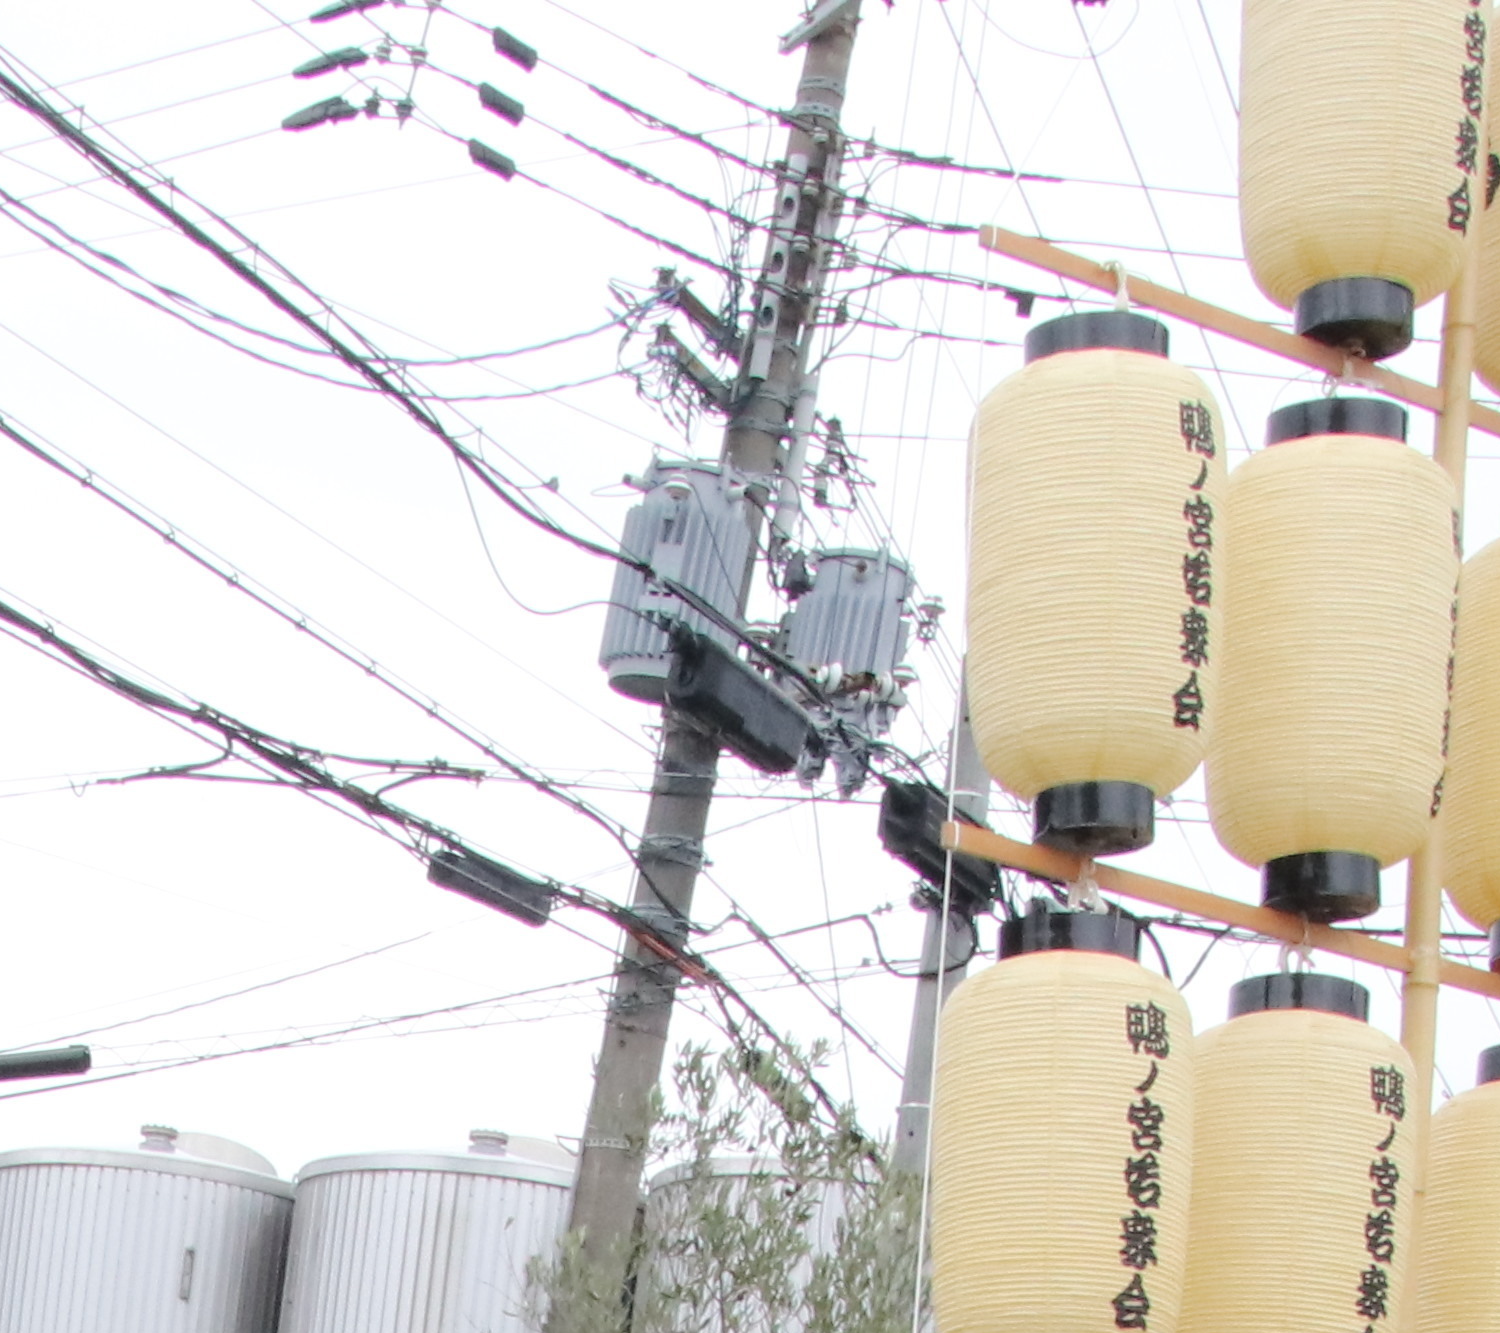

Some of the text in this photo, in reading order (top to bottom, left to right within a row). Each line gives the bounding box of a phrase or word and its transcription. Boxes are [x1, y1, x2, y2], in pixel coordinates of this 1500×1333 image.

[1447, 0, 1485, 238] 宮若衆会
[1111, 1000, 1169, 1331] 鴨ノ宮若衆会
